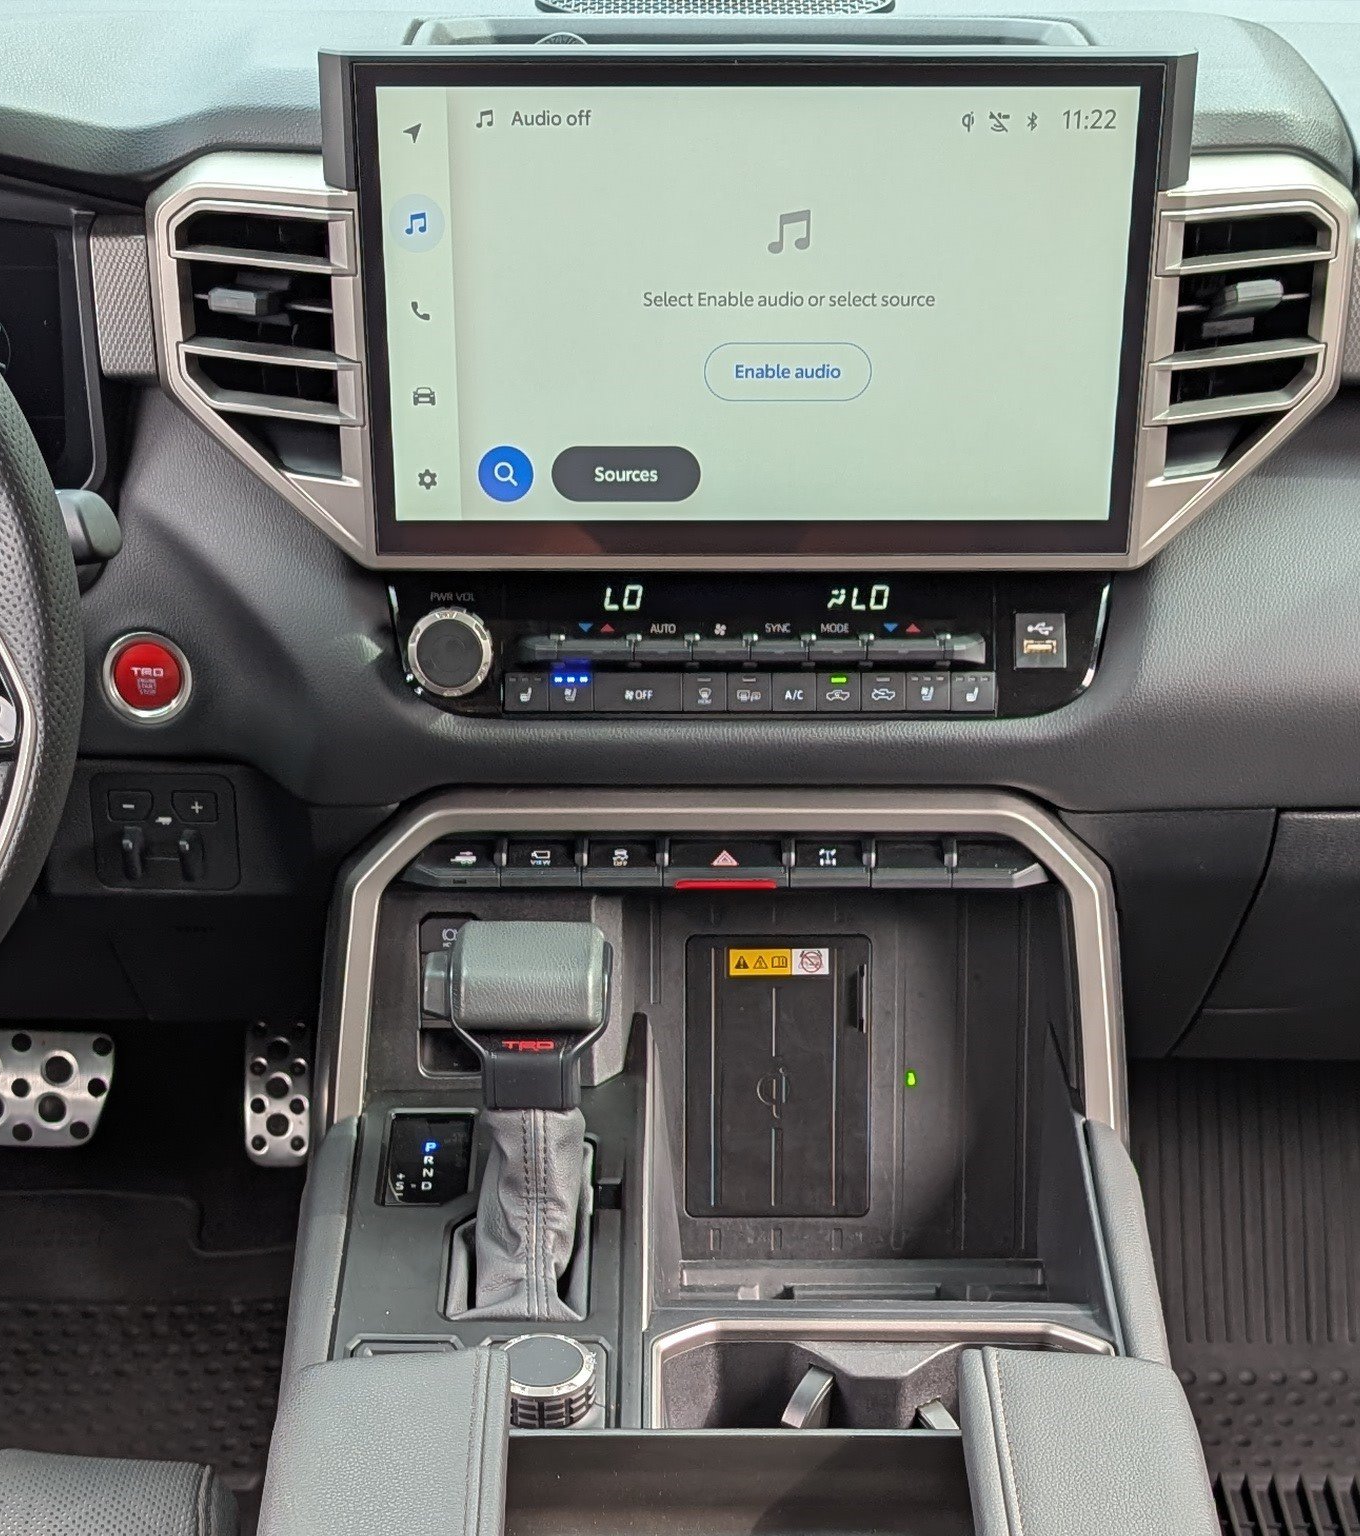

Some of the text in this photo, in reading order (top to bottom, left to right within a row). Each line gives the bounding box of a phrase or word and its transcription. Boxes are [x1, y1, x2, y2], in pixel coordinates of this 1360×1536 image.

[511, 110, 592, 127] Audio off
[1062, 108, 1117, 130] 11:22
[642, 291, 936, 307] Select Enable audio or select source
[734, 363, 842, 380] Enable audio
[594, 466, 659, 482] Sources
[430, 591, 475, 601] PWR VOL
[603, 584, 644, 611] LO
[851, 584, 891, 611] LO
[650, 623, 677, 634] AUTO
[764, 623, 791, 633] SYNC
[820, 623, 850, 634] MODE
[130, 667, 164, 677] TRD
[635, 690, 653, 699] OFF
[784, 689, 804, 700] A/C
[502, 1040, 555, 1051] TRD
[425, 1142, 437, 1153] P
[423, 1155, 435, 1165] R
[422, 1168, 435, 1178] N
[395, 1181, 405, 1191] S
[421, 1181, 433, 1191] D
